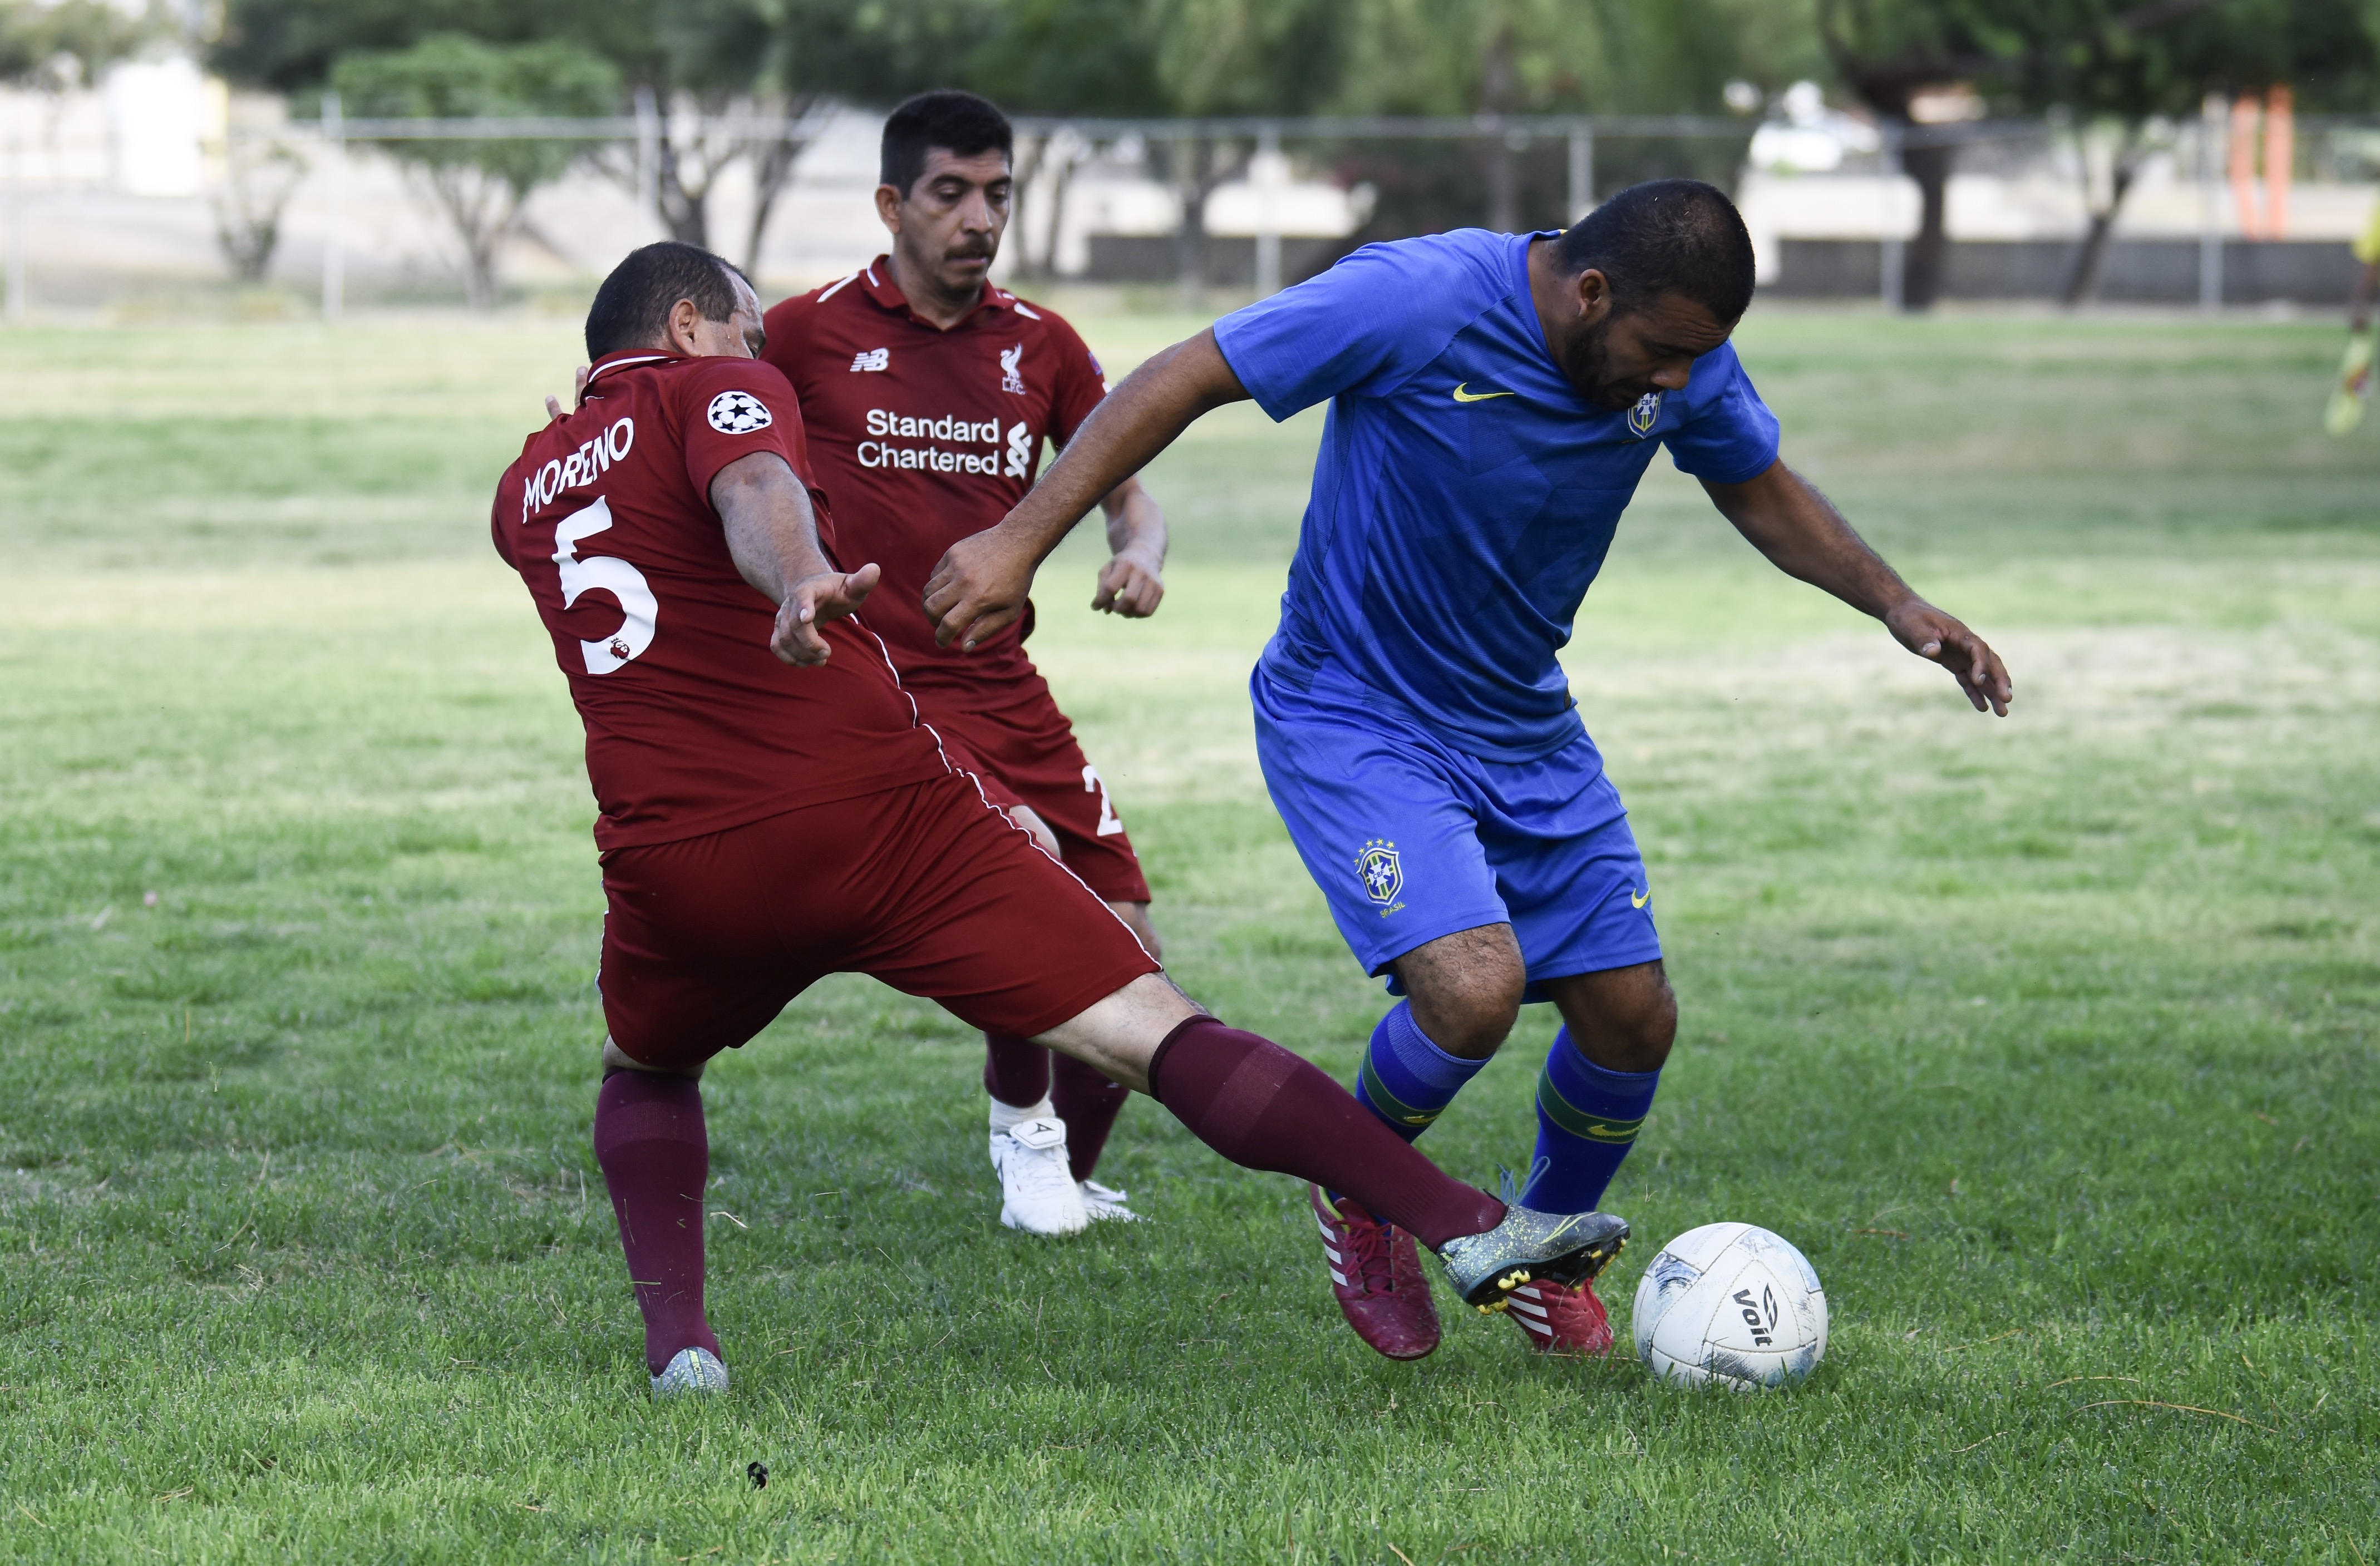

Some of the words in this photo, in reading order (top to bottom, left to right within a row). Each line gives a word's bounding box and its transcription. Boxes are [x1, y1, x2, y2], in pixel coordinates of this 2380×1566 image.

[866, 408, 1000, 443] Standard
[522, 417, 635, 525] MORENO
[857, 441, 999, 476] Chartered
[551, 495, 659, 675] 5
[1081, 764, 1123, 837] 2
[1373, 870, 1385, 880] CBF
[689, 1350, 705, 1388] MERCURIA
